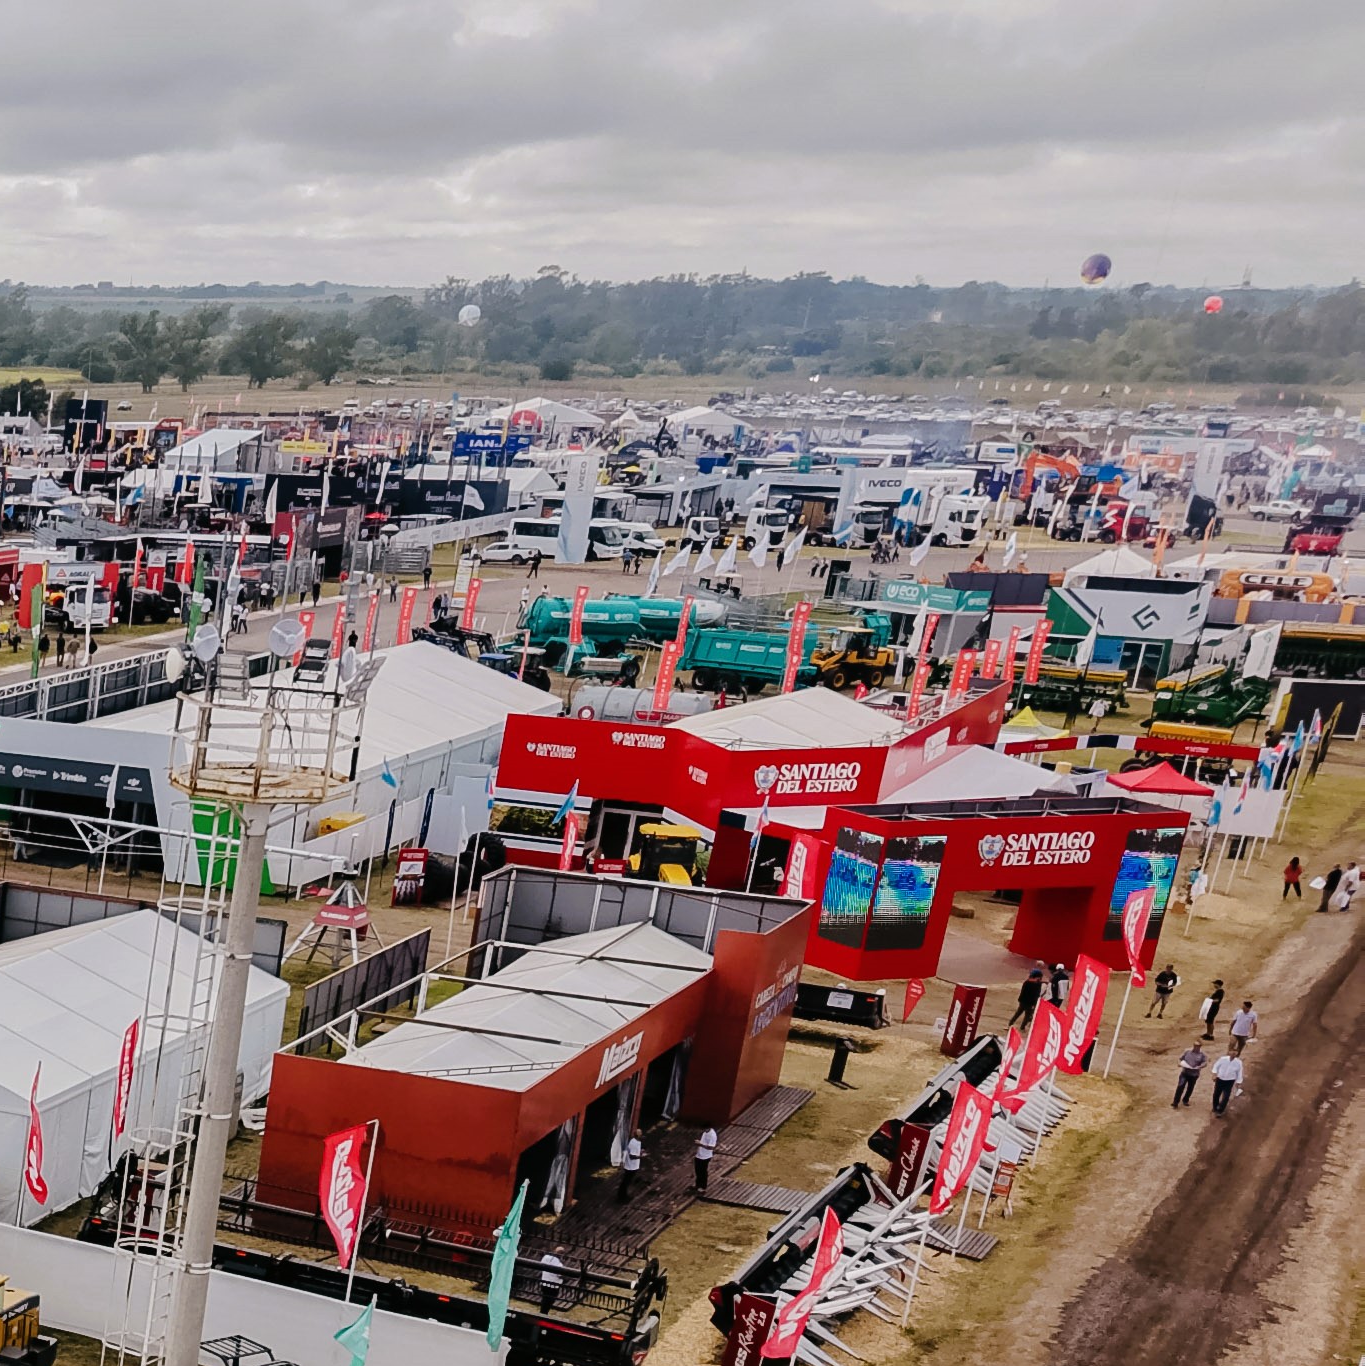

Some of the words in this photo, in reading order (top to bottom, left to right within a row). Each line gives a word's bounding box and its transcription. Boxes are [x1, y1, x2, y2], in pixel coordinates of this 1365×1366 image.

[575, 461, 588, 492] IVECO
[868, 479, 903, 489] IVECO
[622, 740, 636, 748] DEL
[635, 741, 665, 750] ESTERO
[623, 732, 666, 744] SANTIAGO
[536, 750, 549, 758] DEL
[549, 751, 576, 760] ESTERO
[537, 743, 577, 755] SANTIAGO
[60, 771, 88, 784] Trimble
[777, 762, 861, 780] SANTIAGO
[776, 780, 803, 795] DEL
[805, 778, 858, 794] ESTERO
[1005, 830, 1096, 852] SANTIAGO
[1002, 850, 1033, 867] DEL
[1033, 848, 1092, 867] ESTERO
[786, 841, 808, 900] aizco
[1064, 969, 1098, 1068] Maizco
[594, 1030, 645, 1090] Maizco
[938, 1098, 982, 1206] Maizco
